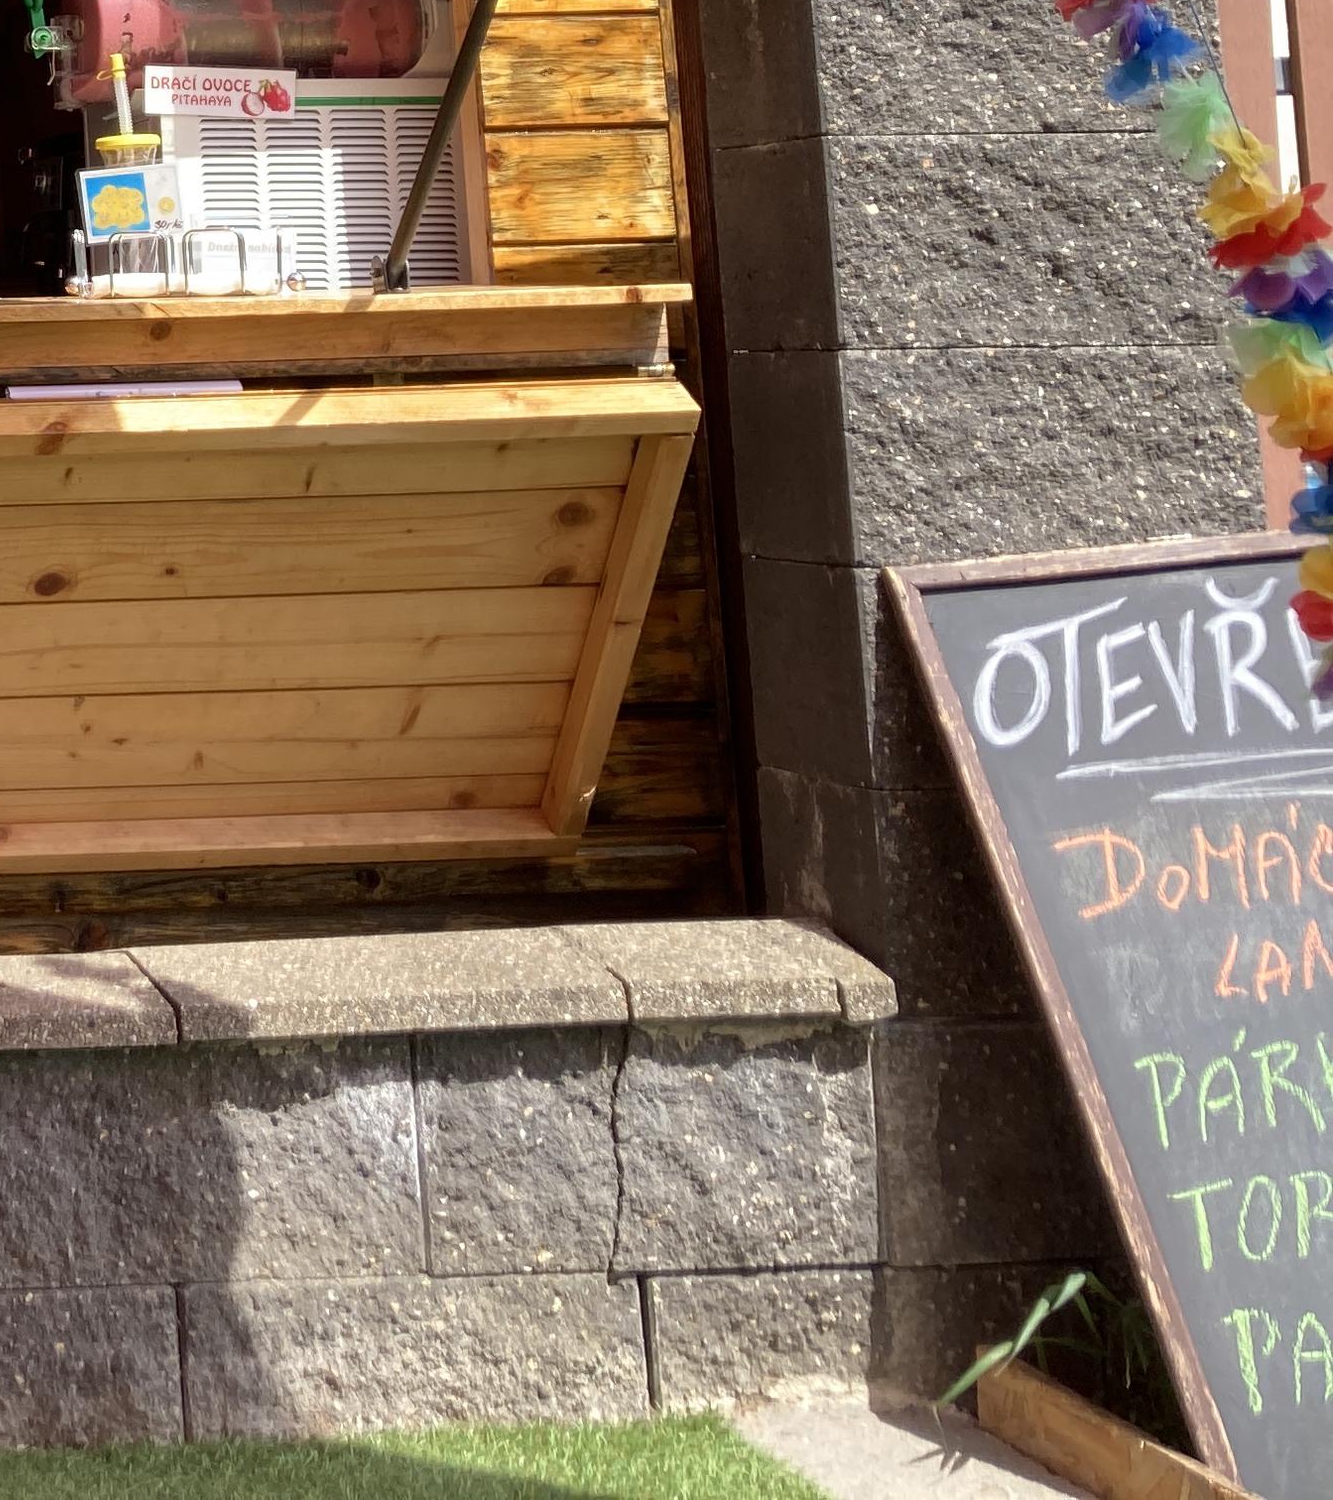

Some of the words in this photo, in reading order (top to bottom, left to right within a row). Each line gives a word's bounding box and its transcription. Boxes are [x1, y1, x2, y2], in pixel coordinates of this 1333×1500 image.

[150, 73, 198, 91] DRAČÍ
[202, 78, 252, 94] OVOCE
[172, 93, 233, 107] PITAHAYA
